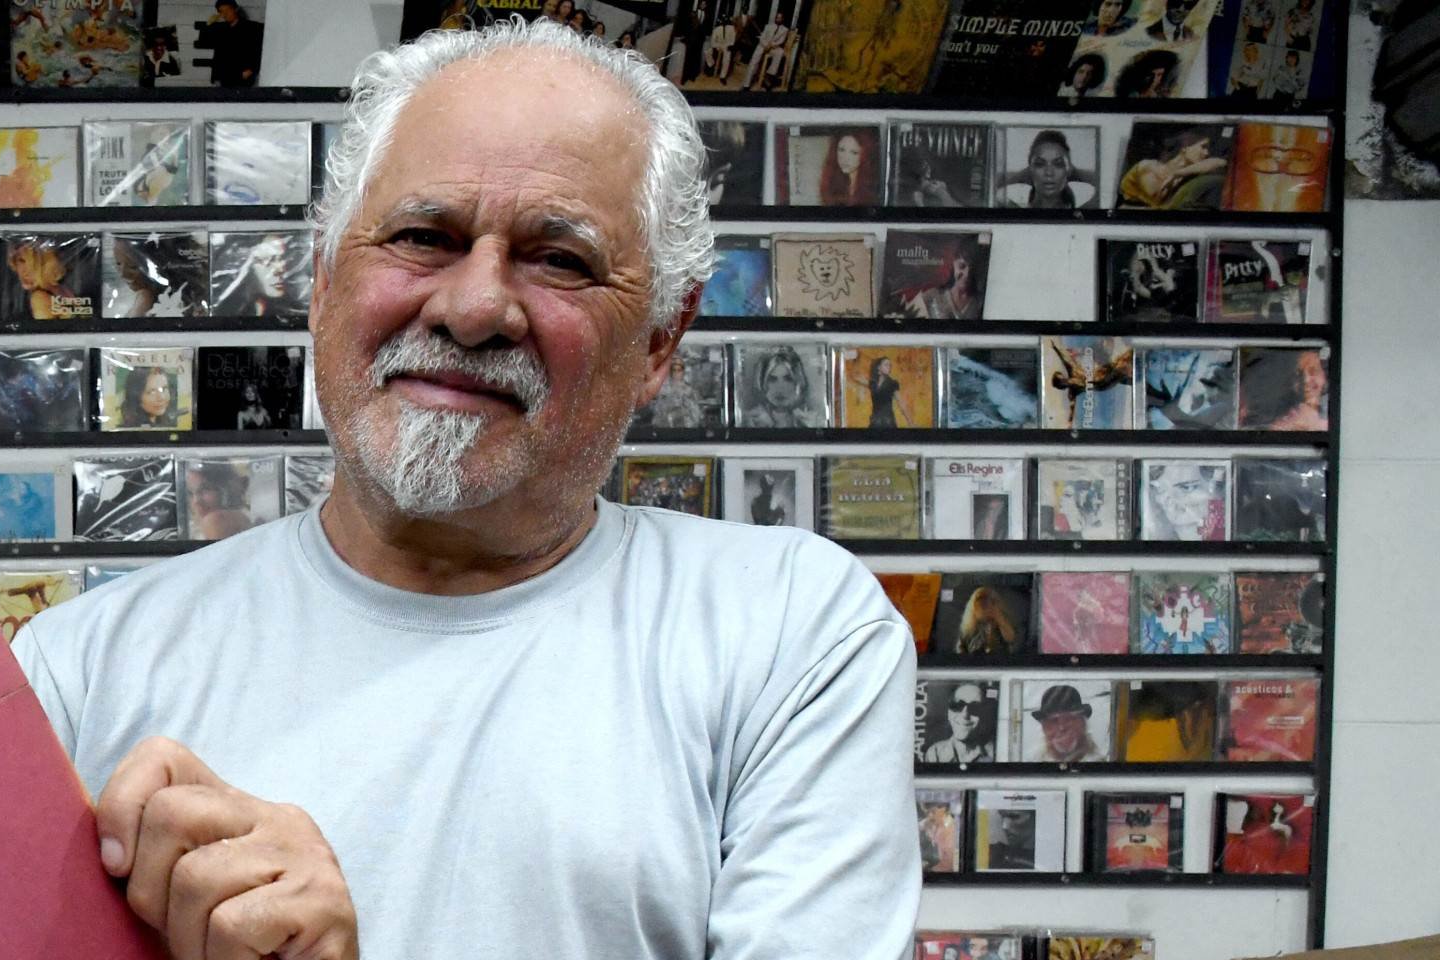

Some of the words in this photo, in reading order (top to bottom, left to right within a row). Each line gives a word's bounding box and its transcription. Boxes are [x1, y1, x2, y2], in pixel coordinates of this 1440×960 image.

[949, 14, 1018, 36] SIMPLE
[1021, 18, 1084, 38] MINDS
[975, 42, 999, 55] you
[51, 296, 92, 306] Karen
[51, 306, 94, 315] Souza
[914, 681, 929, 762] ARTOLA
